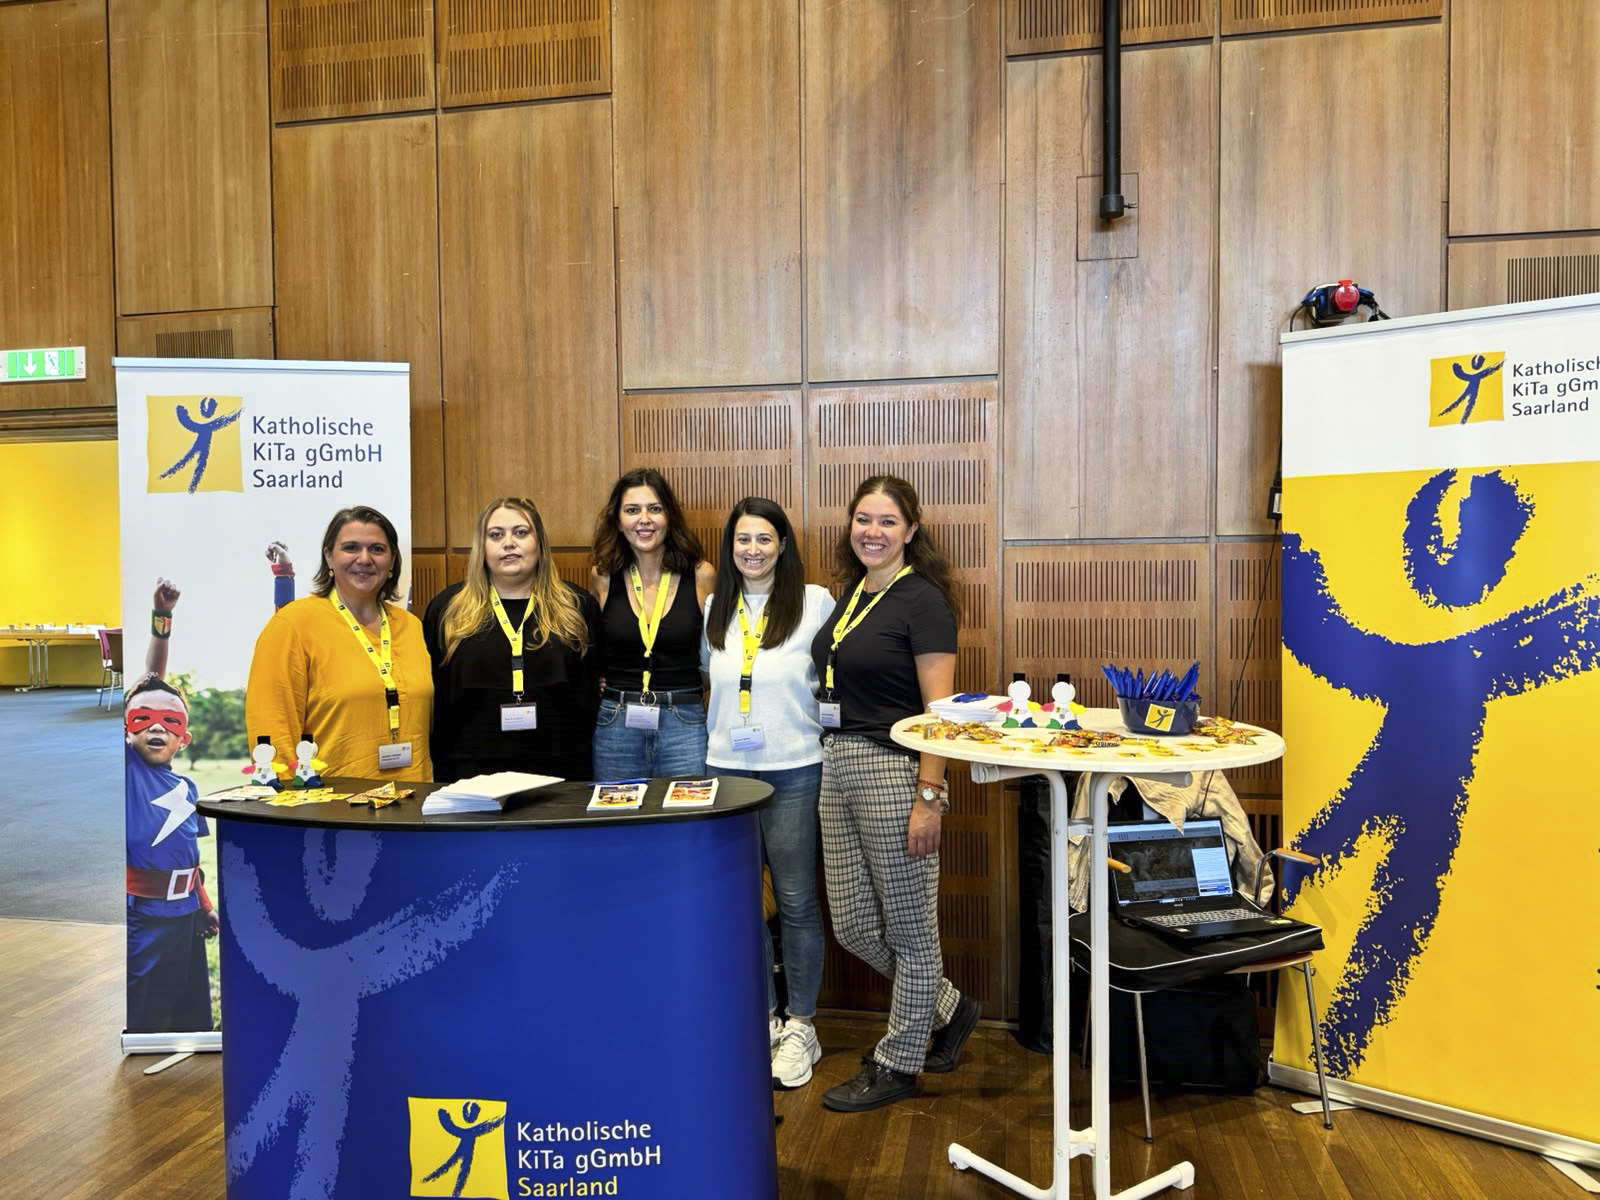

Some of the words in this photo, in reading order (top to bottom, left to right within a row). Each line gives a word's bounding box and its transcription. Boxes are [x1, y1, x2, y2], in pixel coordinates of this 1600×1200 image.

[1513, 381, 1548, 397] KiTa
[1512, 396, 1589, 417] Saarland
[253, 415, 373, 436] Katholische
[253, 442, 295, 462] KiTa
[305, 443, 382, 467] gGmbH
[252, 468, 343, 489] Saarland
[517, 1119, 652, 1142] Katholische
[518, 1149, 564, 1170] KiTa
[575, 1145, 661, 1174] gGmbH
[518, 1175, 618, 1198] Saarland
